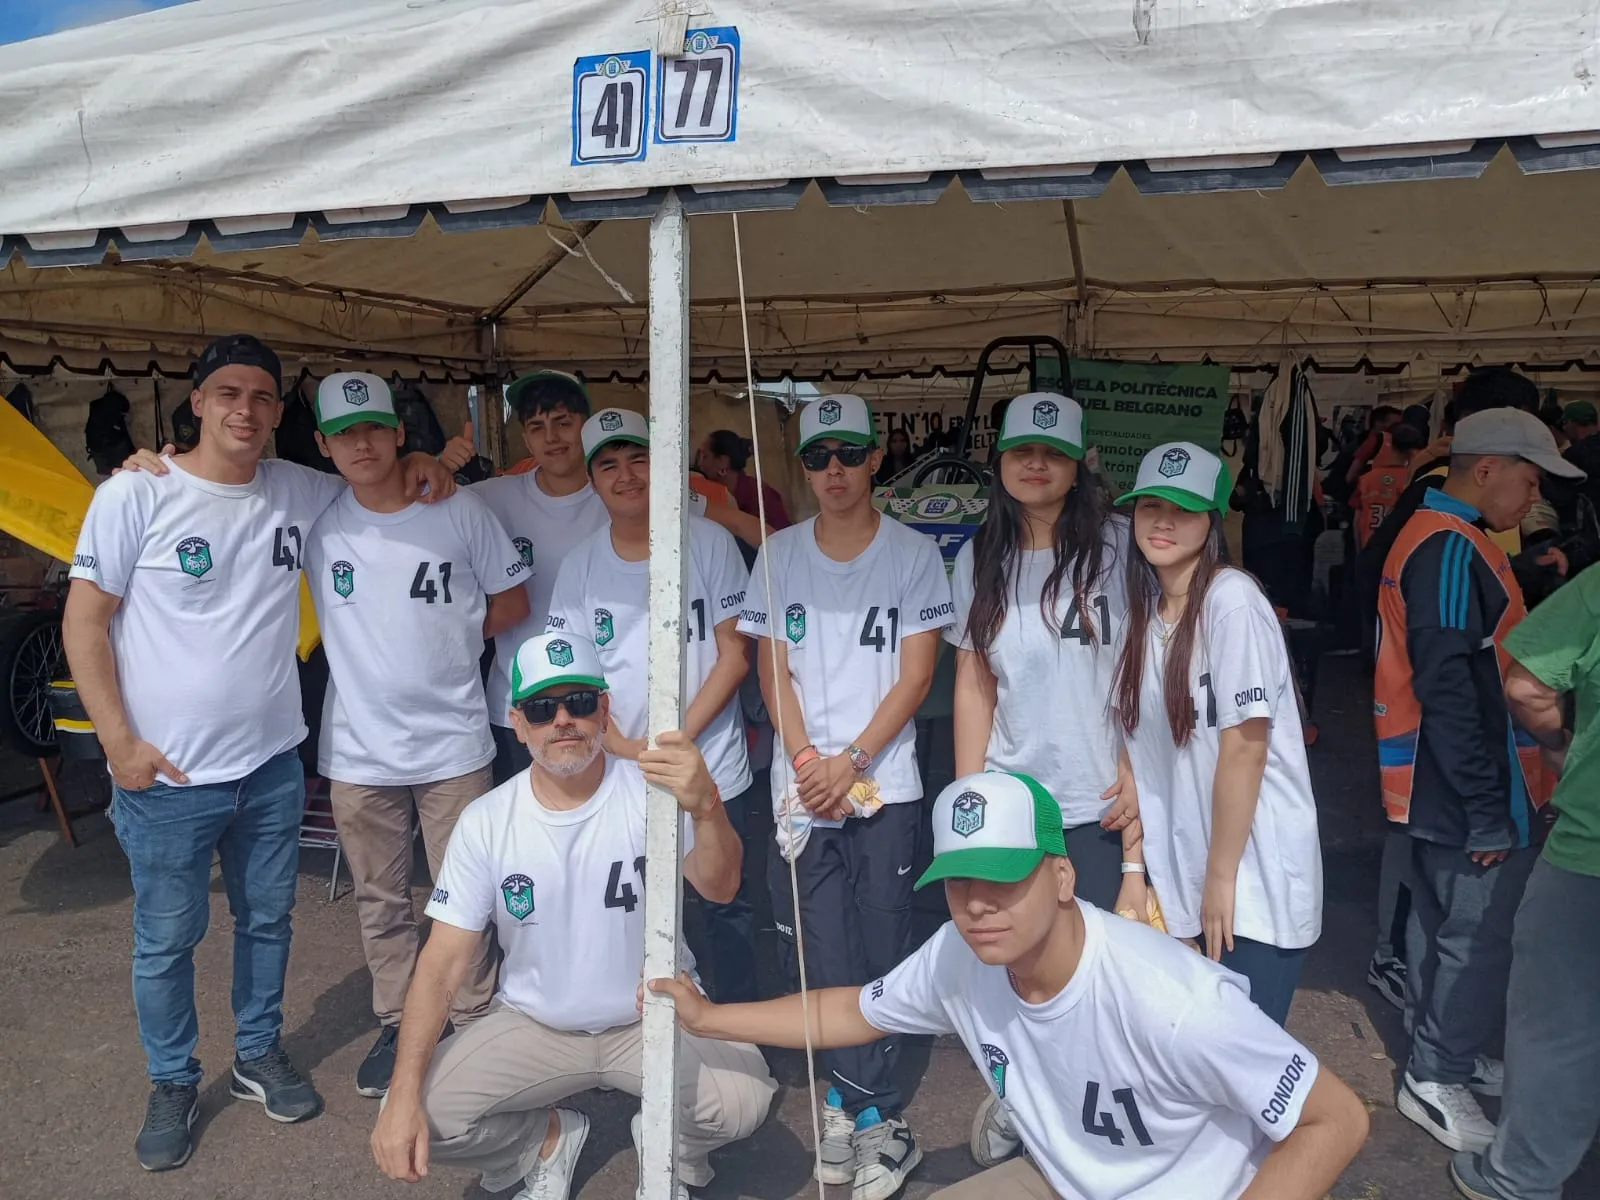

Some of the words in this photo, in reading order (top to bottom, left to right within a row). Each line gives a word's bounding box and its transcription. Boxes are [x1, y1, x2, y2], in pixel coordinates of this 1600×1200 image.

[674, 57, 723, 128] 77
[592, 82, 633, 148] 41
[1110, 381, 1217, 399] POLITÉCNICA
[1114, 401, 1203, 417] BELGRANO
[272, 526, 302, 571] 41
[506, 560, 527, 577] CON
[410, 562, 452, 604] 41
[547, 615, 566, 629] DOR
[687, 598, 706, 643] 1
[739, 609, 767, 625] ONDOR
[859, 606, 899, 653] 41
[919, 601, 955, 621] CONDO
[1060, 595, 1111, 646] 41
[431, 888, 449, 905] DOR
[1260, 1054, 1307, 1126] CONDOR
[1082, 1081, 1155, 1147] 41
